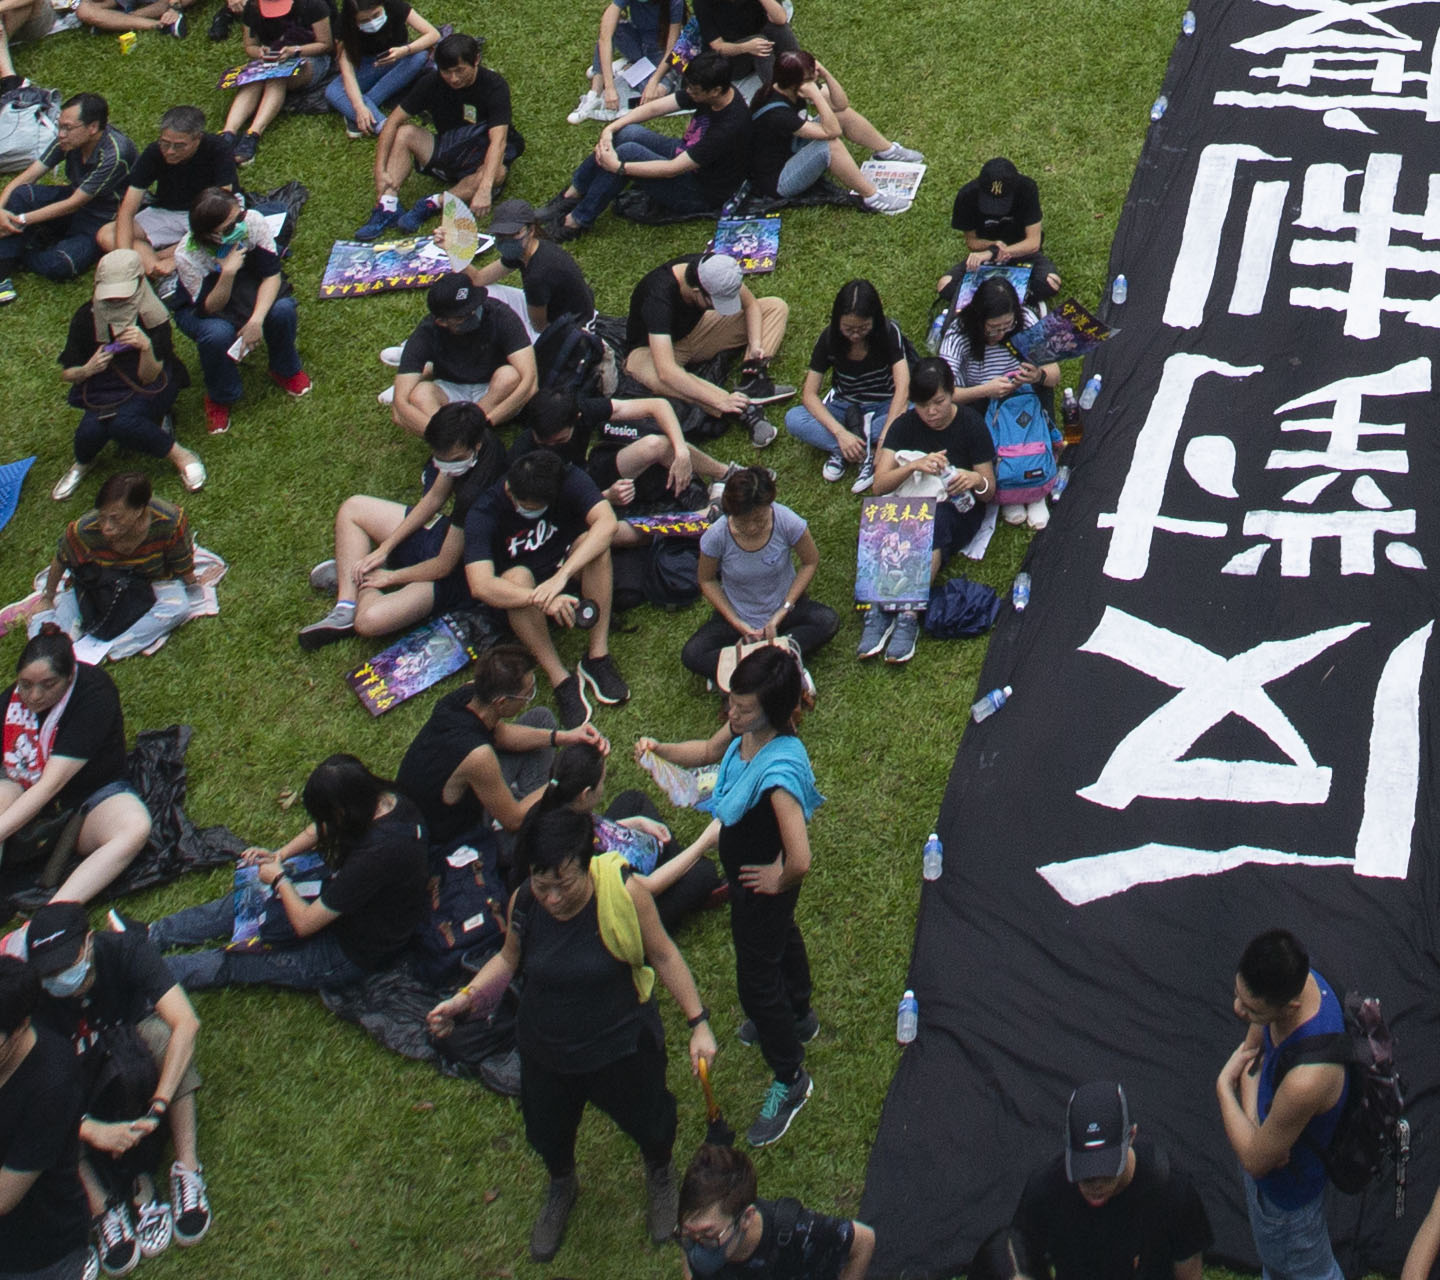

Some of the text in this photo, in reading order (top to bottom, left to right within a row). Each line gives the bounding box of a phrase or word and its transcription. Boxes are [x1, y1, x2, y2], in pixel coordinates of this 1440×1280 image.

[603, 422, 639, 438] Passion
[865, 502, 930, 522] 守護未來
